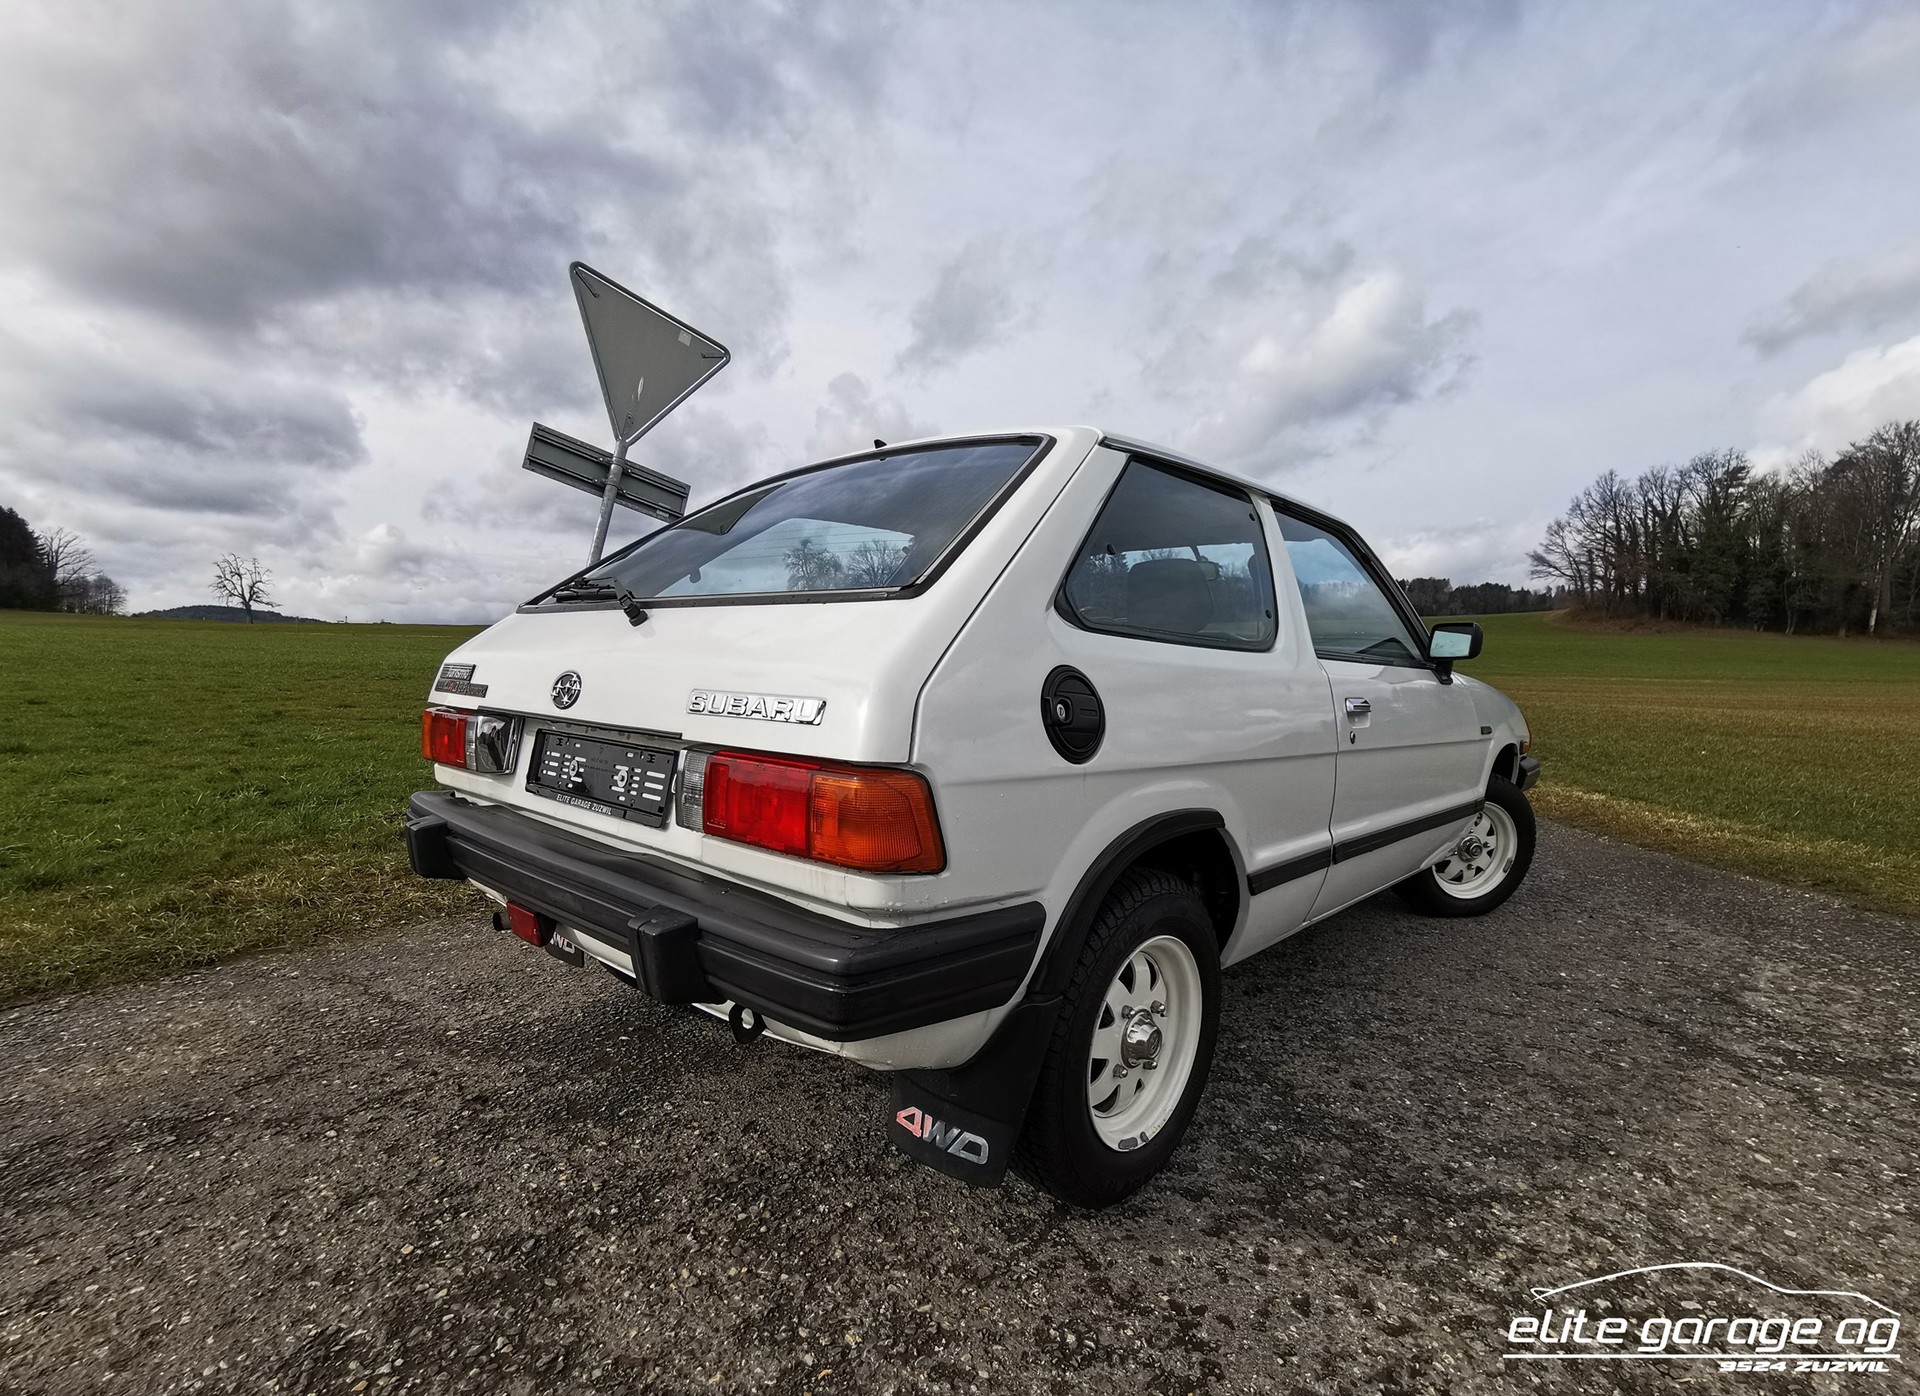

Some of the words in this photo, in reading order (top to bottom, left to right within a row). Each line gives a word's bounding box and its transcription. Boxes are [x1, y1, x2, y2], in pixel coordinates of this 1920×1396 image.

[688, 691, 823, 725] SUBARU
[556, 793, 571, 804] ELITE
[570, 797, 592, 809] GARAGE
[591, 802, 613, 815] ZUZWIL
[550, 931, 575, 954] WD
[896, 1106, 989, 1165] 4WD
